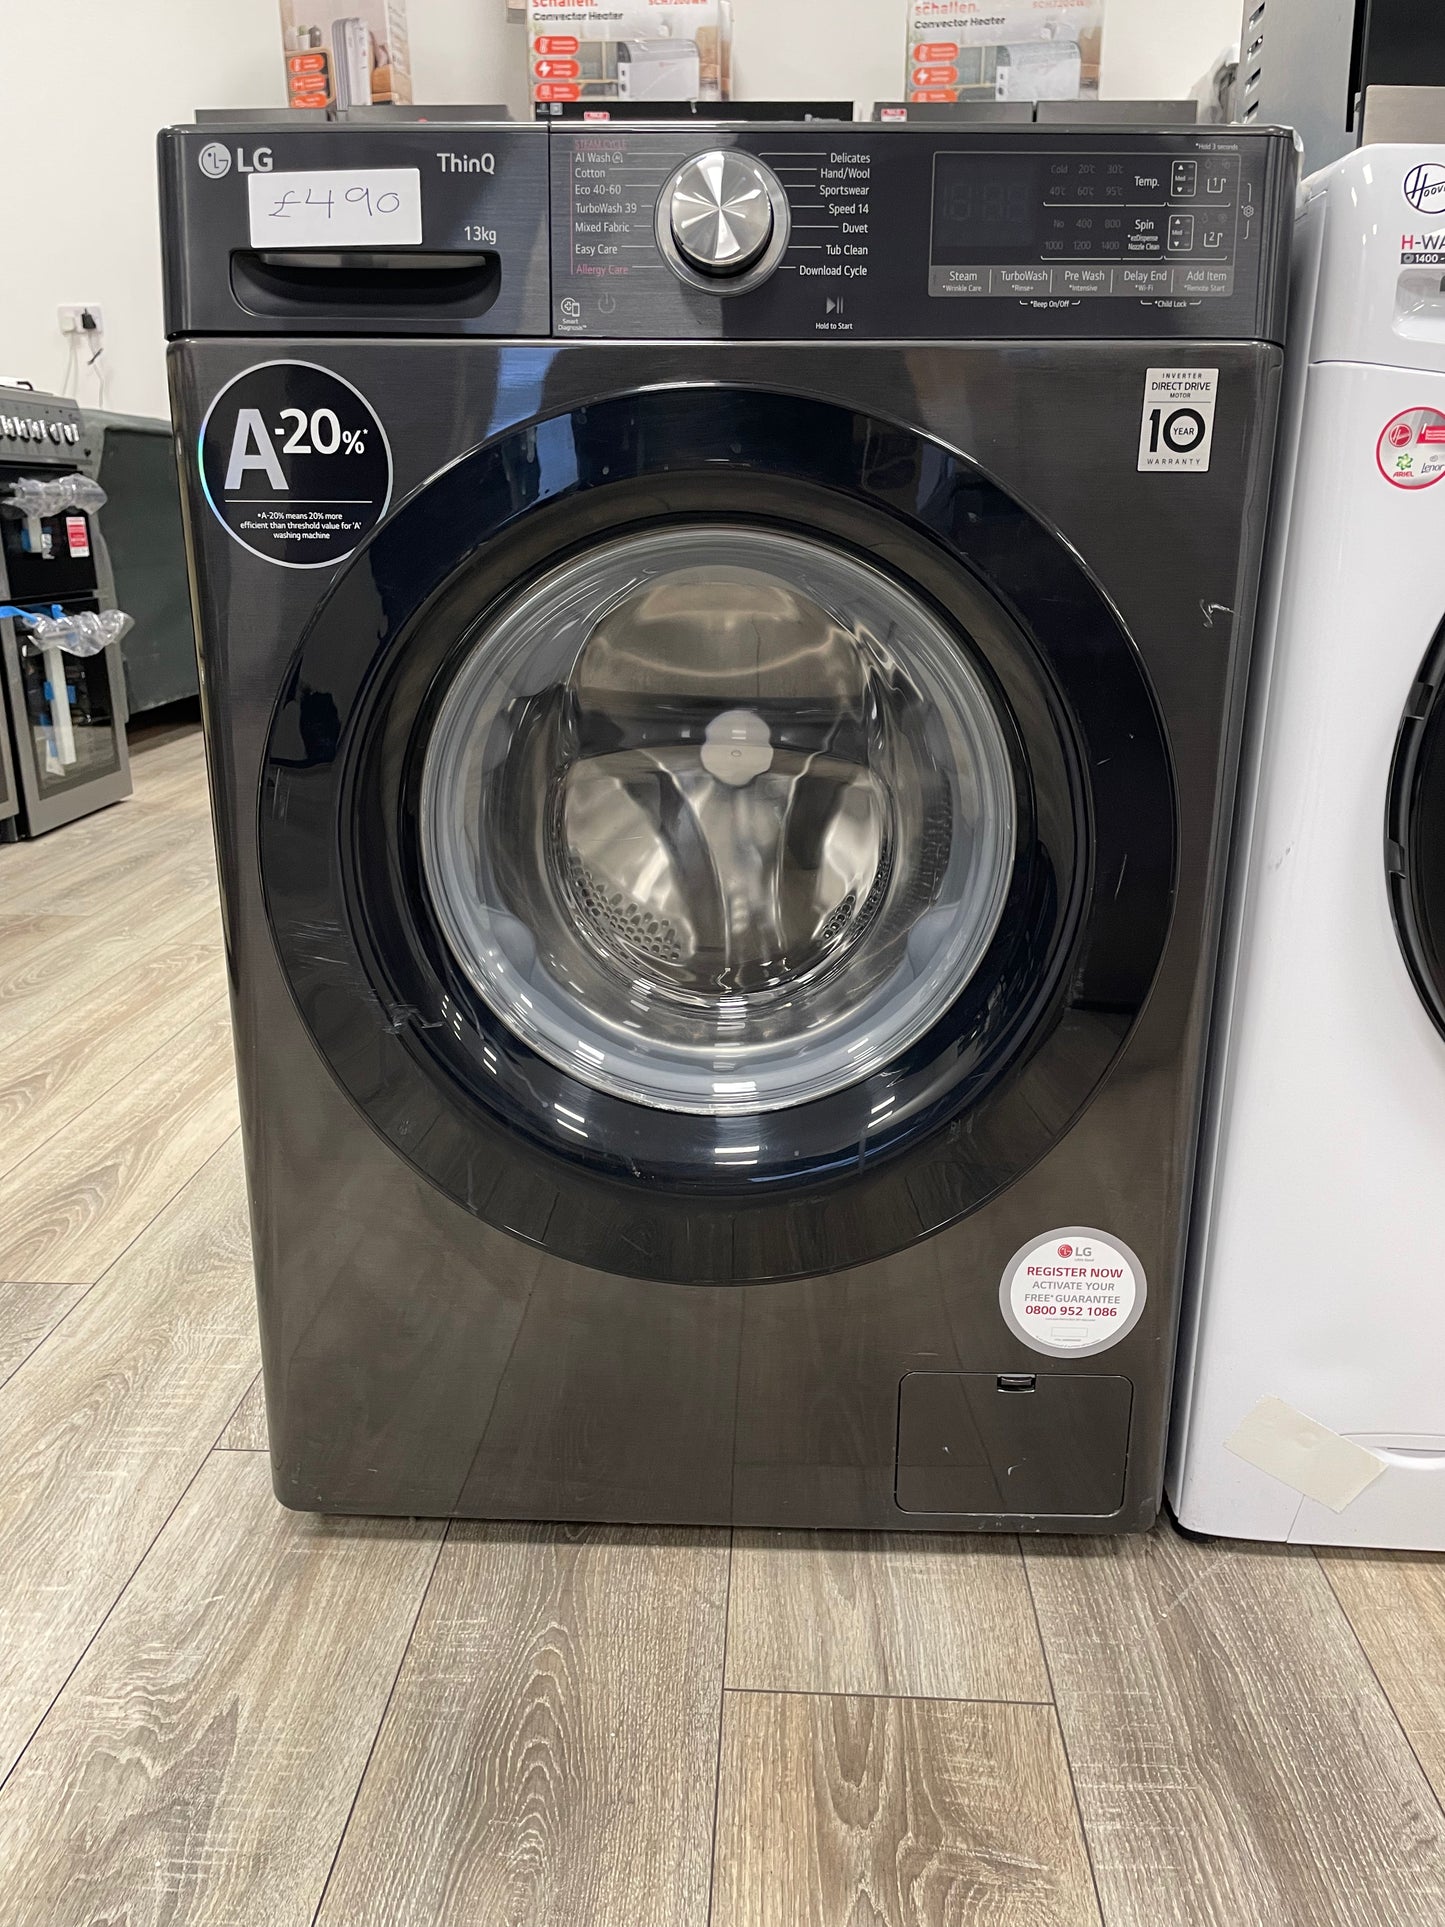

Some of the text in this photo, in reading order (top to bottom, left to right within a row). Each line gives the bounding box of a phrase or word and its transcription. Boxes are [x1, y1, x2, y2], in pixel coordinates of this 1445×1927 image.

[588, 12, 623, 20] Heater
[914, 17, 1006, 29] Convector Heater
[237, 147, 274, 172] LG
[575, 152, 584, 162] AI
[588, 152, 610, 162] Wash
[830, 152, 871, 163] Delicates
[436, 153, 495, 174] ThinQ
[575, 168, 606, 178] Cotton
[820, 167, 870, 179] Hand/Wool
[1051, 164, 1068, 174] Cold
[1134, 176, 1160, 188] Temp.
[575, 184, 622, 194] Eco 40-60
[820, 185, 870, 198] Sportswear
[268, 187, 400, 218] £490
[576, 203, 637, 213] TurboWash 39
[829, 204, 869, 216] Speed 14
[575, 222, 630, 232] Mixed Fabric
[842, 222, 868, 233] Duvet
[1076, 220, 1092, 228] 400
[1104, 220, 1120, 228] 800
[1135, 220, 1154, 232] Spin
[464, 226, 496, 245] 13kg
[575, 244, 618, 256] Easy Care
[826, 244, 868, 255] Tub Clean
[1045, 241, 1120, 250] 1000 1200 1400
[1416, 254, 1438, 262] 1400
[576, 264, 628, 276] Allergy Care
[800, 265, 868, 278] Download Cycle
[950, 271, 978, 280] Steam
[1001, 271, 1048, 280] TurboWash
[1064, 271, 1104, 280] Pre Wash
[1124, 271, 1167, 283] Delay End
[1187, 271, 1226, 280] Add Item
[968, 284, 982, 292] Care
[1210, 284, 1225, 292] Start
[1049, 300, 1070, 308] On/Off
[1174, 300, 1187, 308] Lock
[1152, 382, 1211, 390] DIRECT DRIVE
[1149, 408, 1206, 453] 10
[1174, 428, 1194, 436] YEAR
[1421, 463, 1445, 474] Lenor
[308, 512, 324, 520] 20%
[240, 521, 268, 529] efficient
[287, 522, 320, 530] threshold
[321, 522, 340, 530] value
[341, 522, 352, 530] for
[273, 532, 301, 540] washing
[1076, 1246, 1092, 1256] LG
[1027, 1266, 1123, 1278] REGISTER NOW
[1032, 1281, 1114, 1291] ACTIVATE YOUR
[1056, 1294, 1120, 1304] GUARANTEE
[1026, 1306, 1118, 1316] 0800 952 1086
